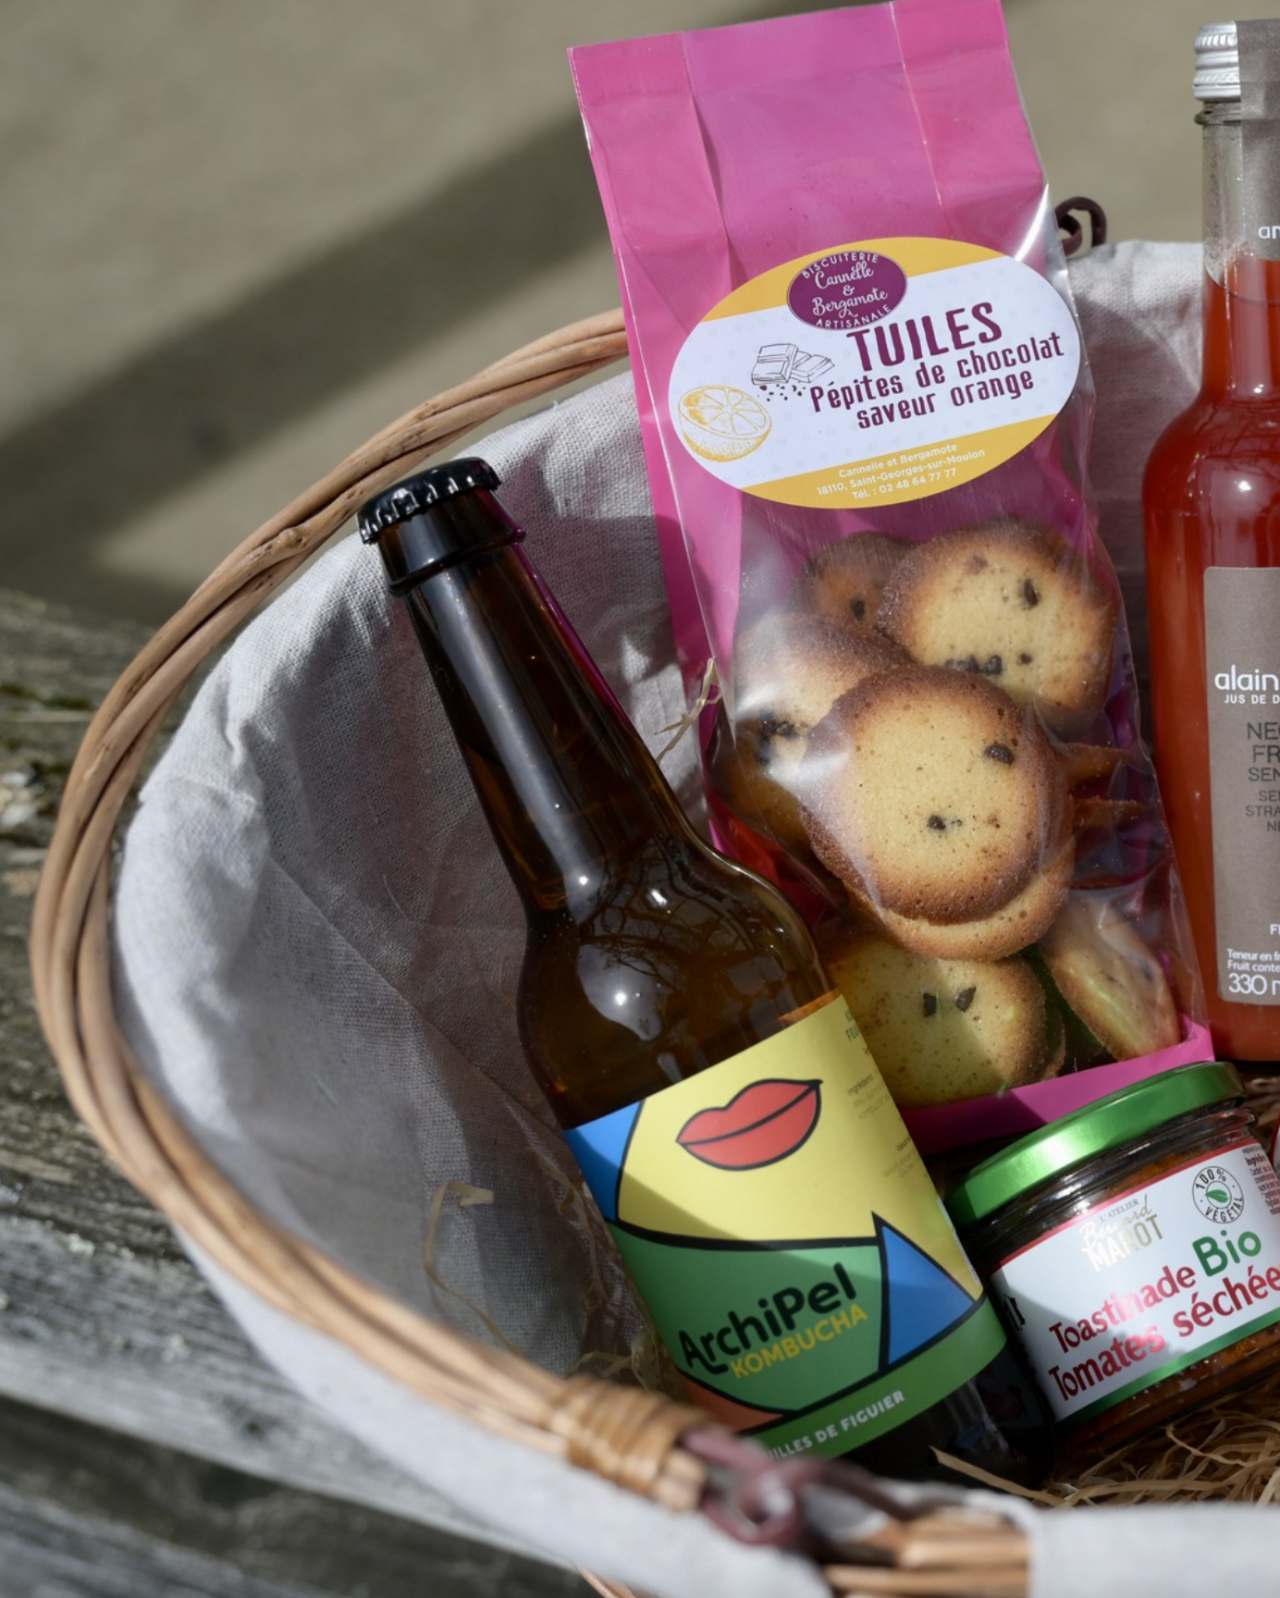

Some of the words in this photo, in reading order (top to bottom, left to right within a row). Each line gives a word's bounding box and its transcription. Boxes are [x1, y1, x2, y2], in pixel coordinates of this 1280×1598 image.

[802, 252, 879, 279] BISCUITERIE
[815, 261, 874, 289] Cannelle
[812, 287, 888, 318] Bergamote
[842, 285, 855, 296] &
[816, 304, 891, 329] ARTISANALE
[846, 302, 1002, 371] TUILES
[810, 375, 903, 412] Pépites
[915, 362, 945, 388] de
[957, 332, 1064, 379] chocolat
[857, 393, 936, 429] saveur
[950, 370, 1034, 407] orange
[839, 461, 884, 478] Cannelle
[887, 458, 897, 468] et
[900, 444, 957, 464] Bergamote
[851, 449, 986, 488] Saint-Georges-sur-Moulon
[879, 484, 893, 494] 02
[912, 477, 926, 486] 64
[929, 472, 941, 482] 77
[944, 468, 956, 478] 77
[1214, 664, 1279, 691] alain
[1224, 694, 1246, 704] JUS
[1251, 694, 1266, 704] DE
[1227, 948, 1258, 960] Teneur
[1259, 952, 1272, 961] en
[1227, 960, 1249, 971] Fruit
[1228, 973, 1268, 995] 330
[1195, 1169, 1227, 1192] 100%
[1100, 1199, 1140, 1223] L'ATELIER
[1205, 1197, 1244, 1223] VÉGÉTAL
[1082, 1214, 1163, 1272] MAROT
[1049, 1265, 1197, 1353] Toastinade
[1192, 1229, 1262, 1277] Bio
[729, 1303, 868, 1379] KOMBUCHA
[1048, 1325, 1167, 1402] Tomates
[815, 1424, 838, 1443] DE
[840, 1390, 906, 1431] FIGUIER
